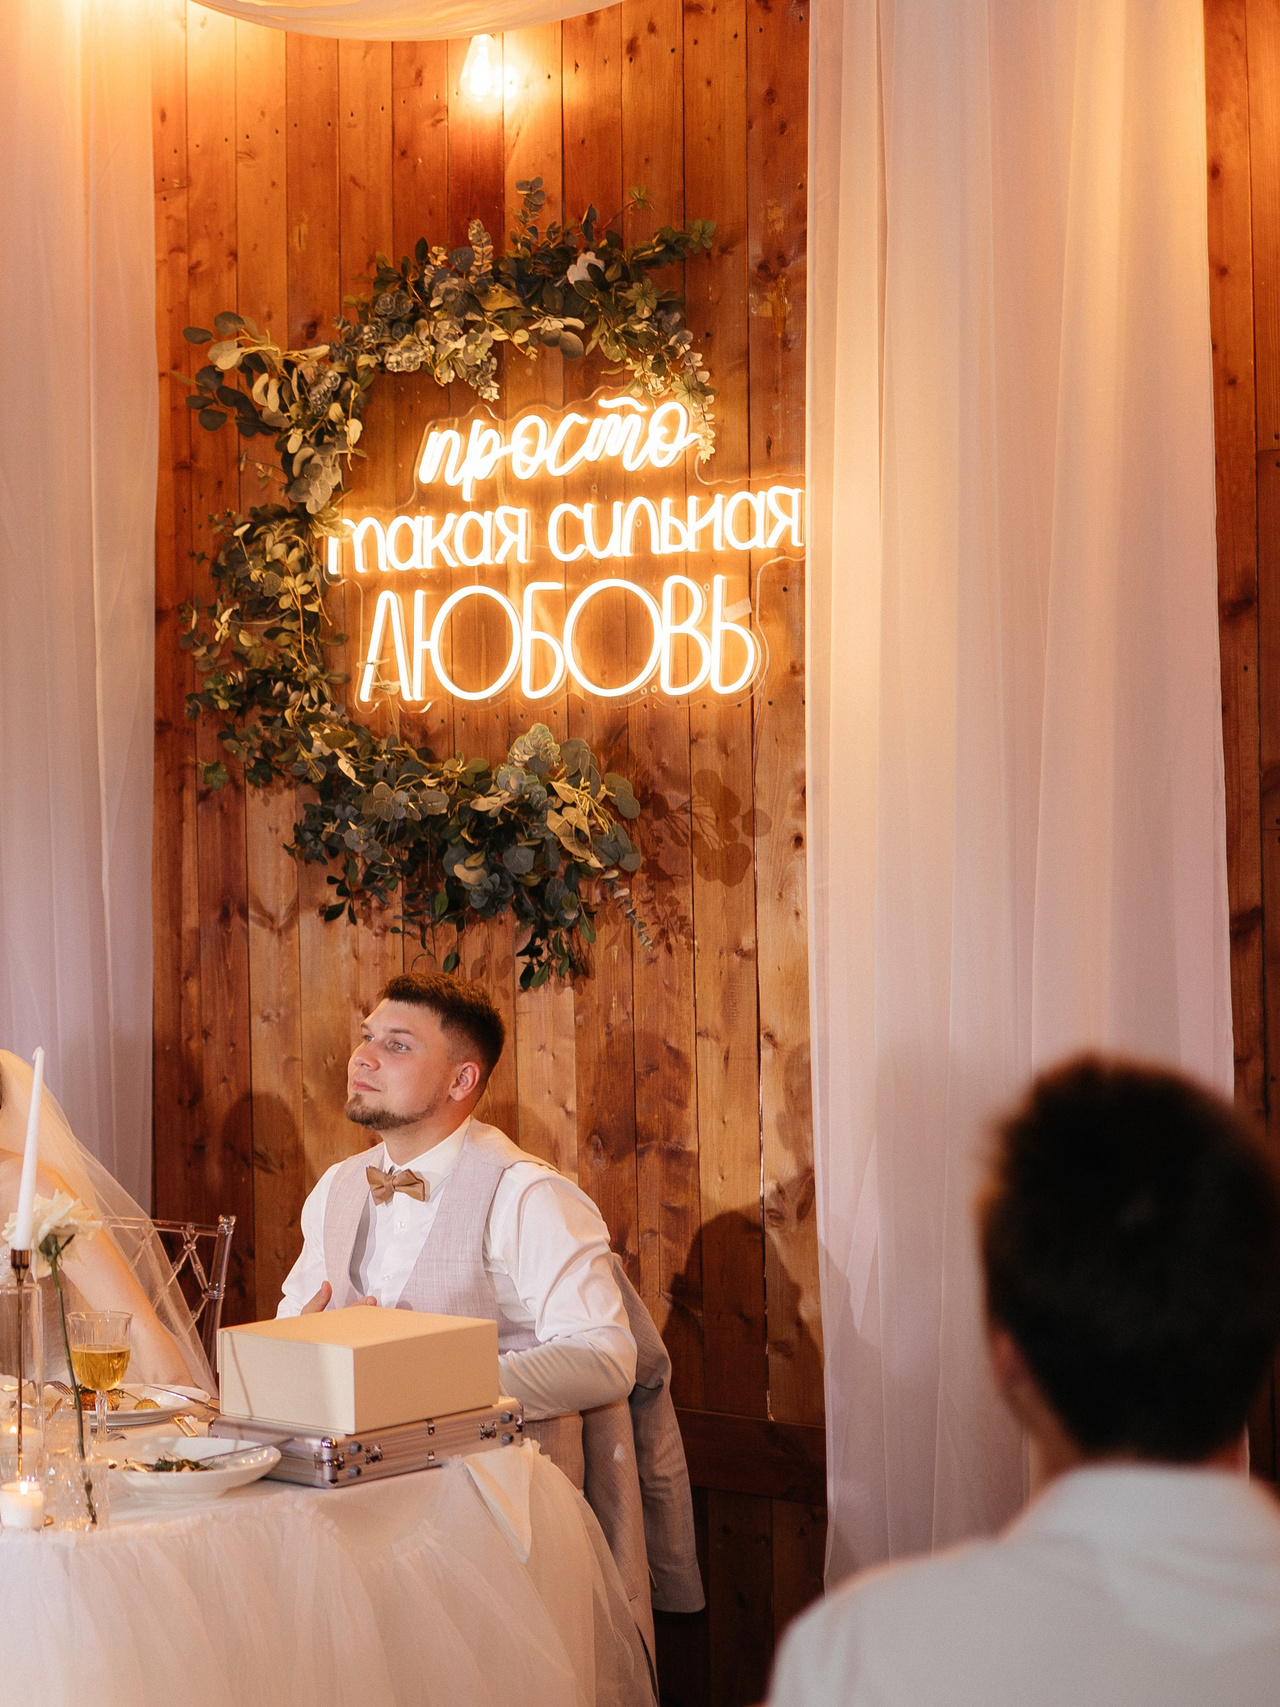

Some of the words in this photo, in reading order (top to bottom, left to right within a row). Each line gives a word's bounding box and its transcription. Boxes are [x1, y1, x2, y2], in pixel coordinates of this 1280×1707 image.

[419, 396, 701, 501] просто
[328, 505, 528, 575] такая
[548, 485, 804, 562] сильная
[360, 574, 757, 701] ЛЮБОВЬ
